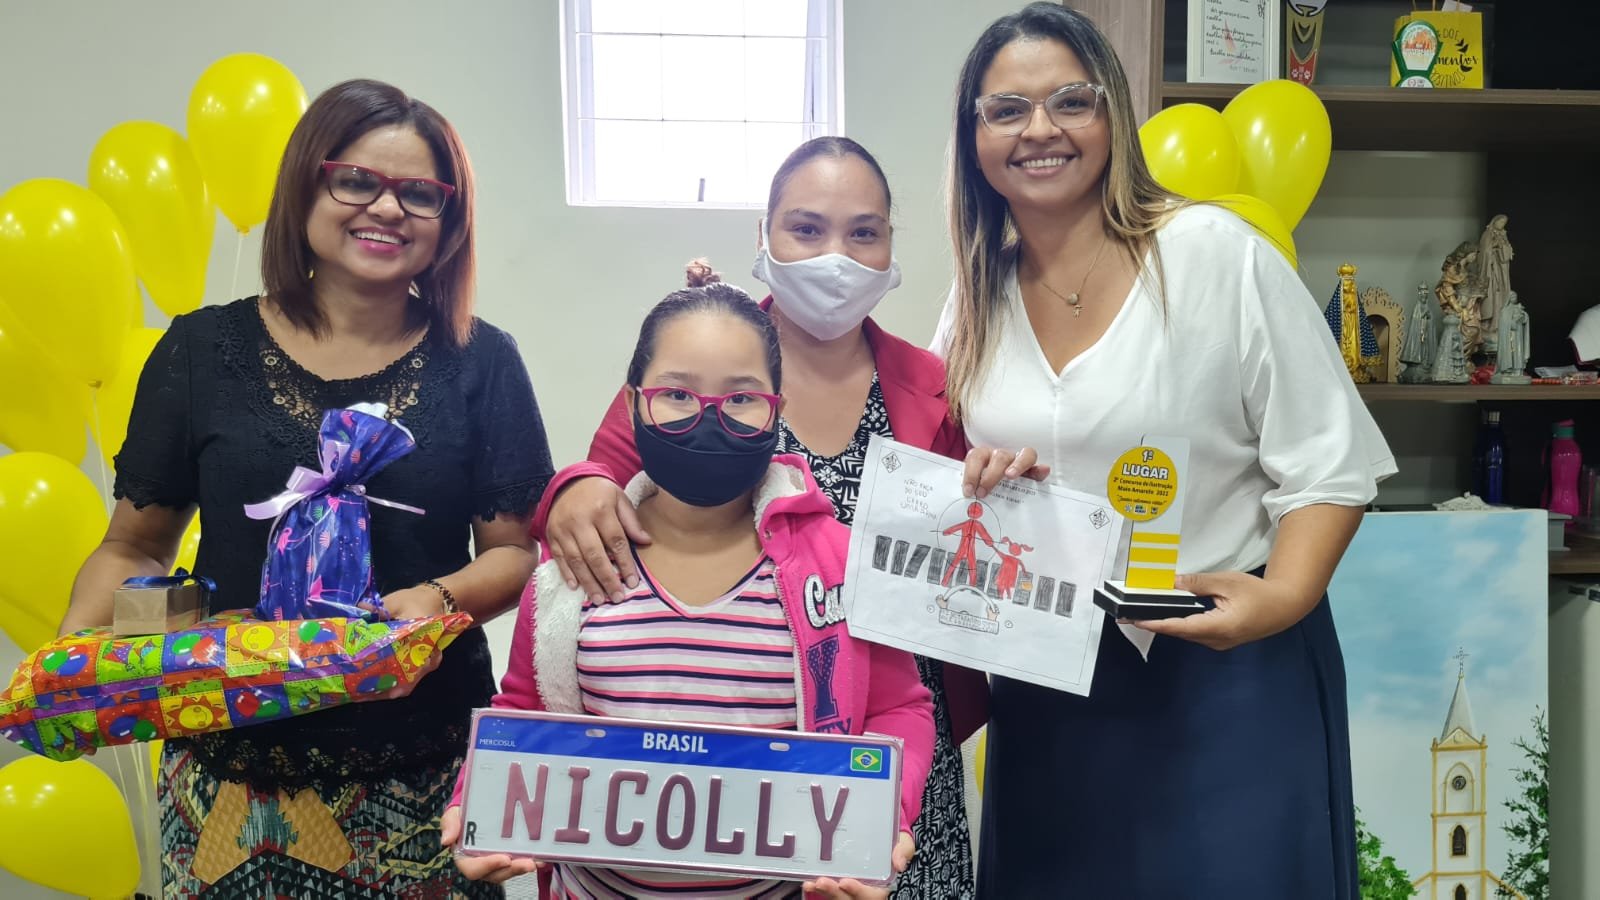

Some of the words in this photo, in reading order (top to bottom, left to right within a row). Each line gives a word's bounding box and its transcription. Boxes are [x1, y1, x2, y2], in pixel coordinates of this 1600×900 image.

[1122, 462, 1169, 481] LUGAR
[479, 737, 517, 748] MERCOSUL
[642, 731, 709, 754] BRASIL
[500, 761, 850, 862] NICOLLY
[464, 820, 477, 847] R
